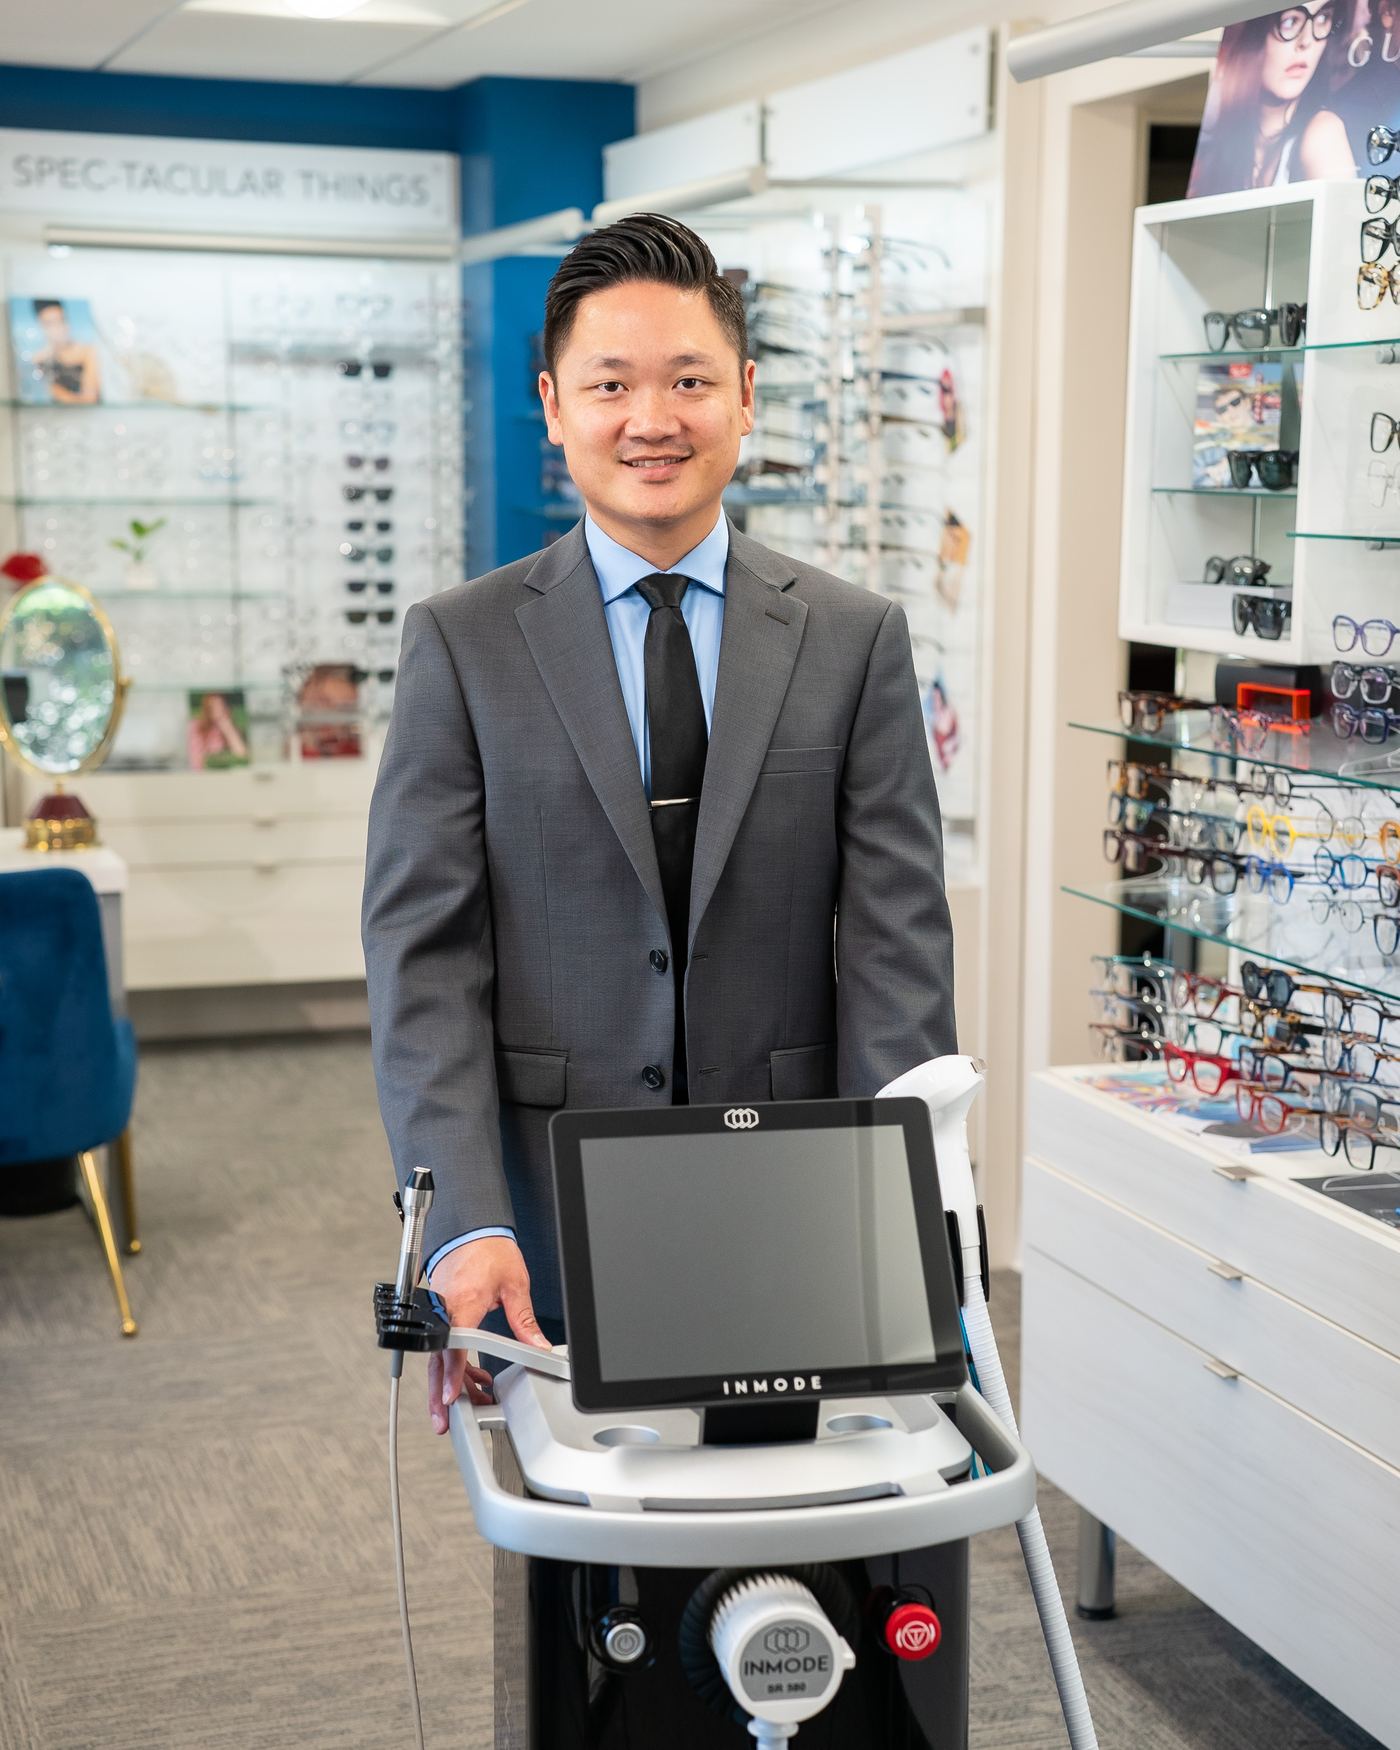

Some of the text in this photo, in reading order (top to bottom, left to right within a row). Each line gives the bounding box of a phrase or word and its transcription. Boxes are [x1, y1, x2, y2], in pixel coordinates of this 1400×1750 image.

[14, 154, 430, 207] SPEC-TACULAR THINGS
[723, 1375, 822, 1395] INMODE
[744, 1655, 828, 1676] INMODE
